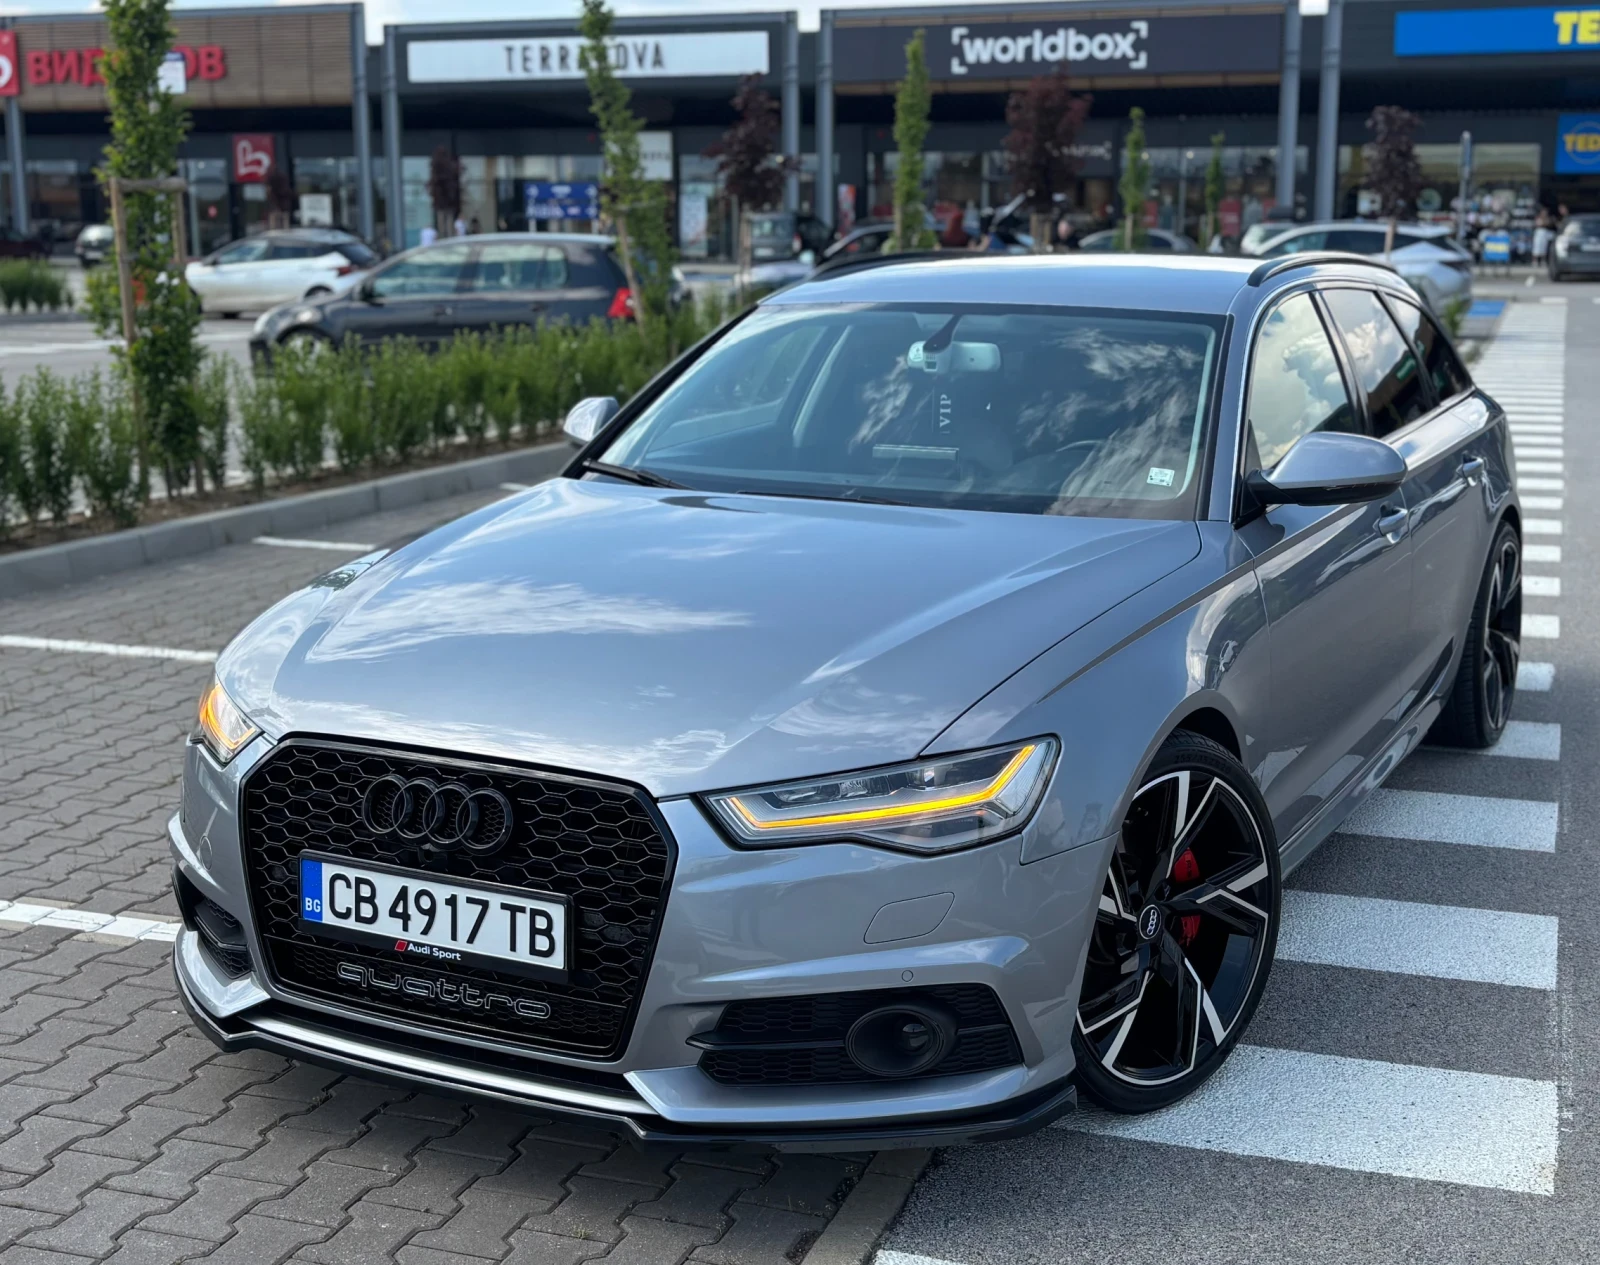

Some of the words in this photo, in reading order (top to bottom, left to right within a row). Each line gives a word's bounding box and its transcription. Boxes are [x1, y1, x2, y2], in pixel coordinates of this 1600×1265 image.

[962, 28, 1137, 64] worldbox
[305, 897, 322, 914] BG
[328, 873, 379, 926] CB
[388, 885, 490, 945] 4917
[500, 902, 557, 958] TB
[407, 942, 431, 956] Audi
[432, 947, 462, 961] Sport
[337, 961, 551, 1019] quattro
